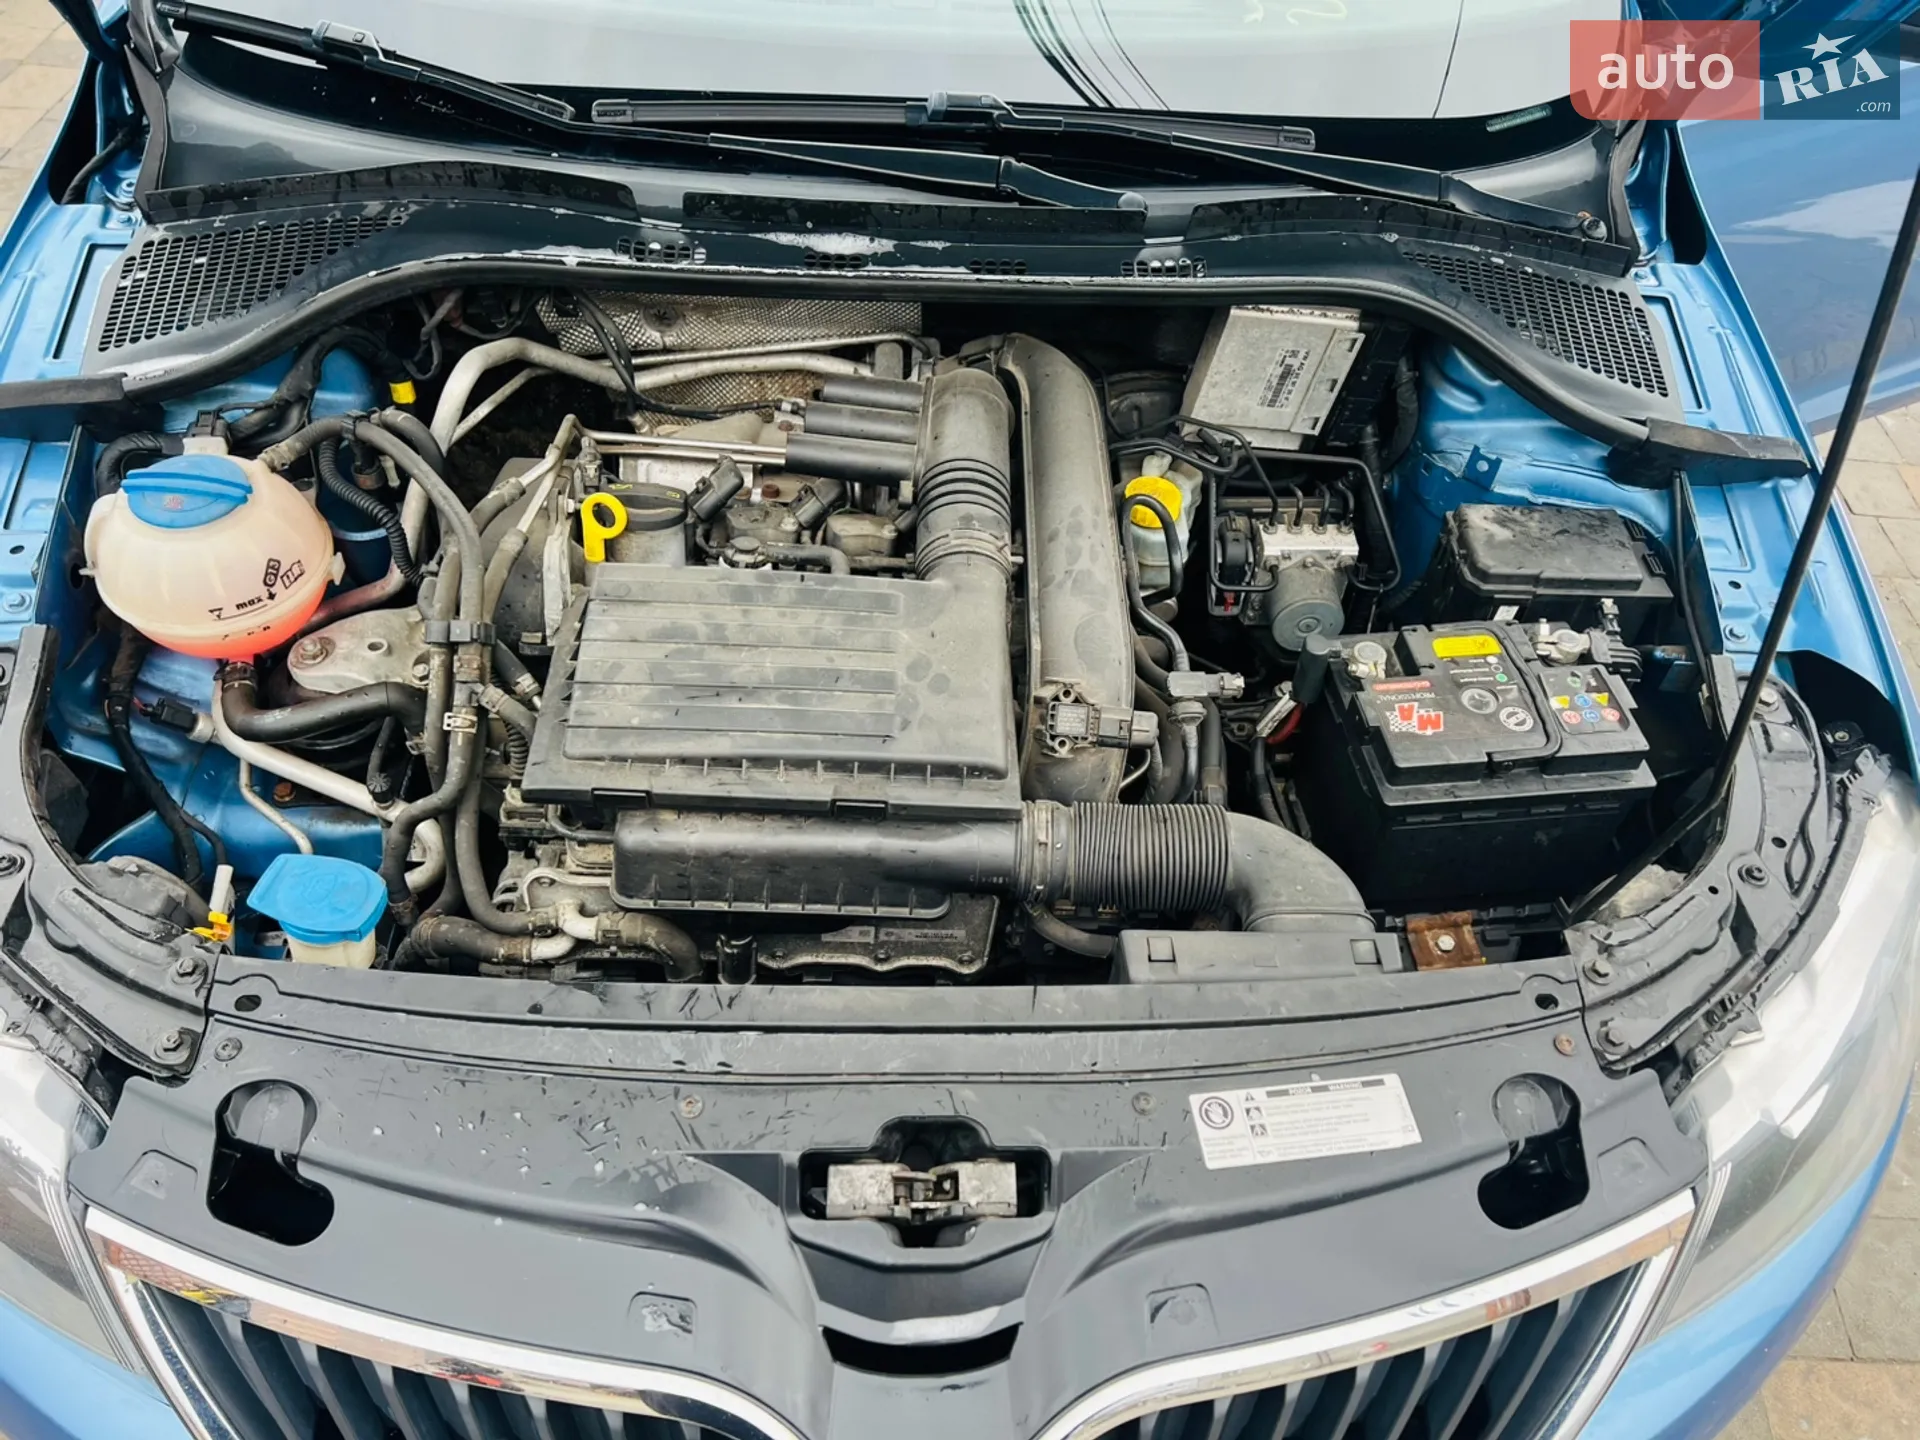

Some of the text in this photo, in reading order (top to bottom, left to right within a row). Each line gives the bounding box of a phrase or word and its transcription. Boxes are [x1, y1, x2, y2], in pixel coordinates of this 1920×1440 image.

[265, 561, 279, 585] G13
[235, 595, 264, 610] max
[1379, 692, 1436, 701] PROFESSIONAL
